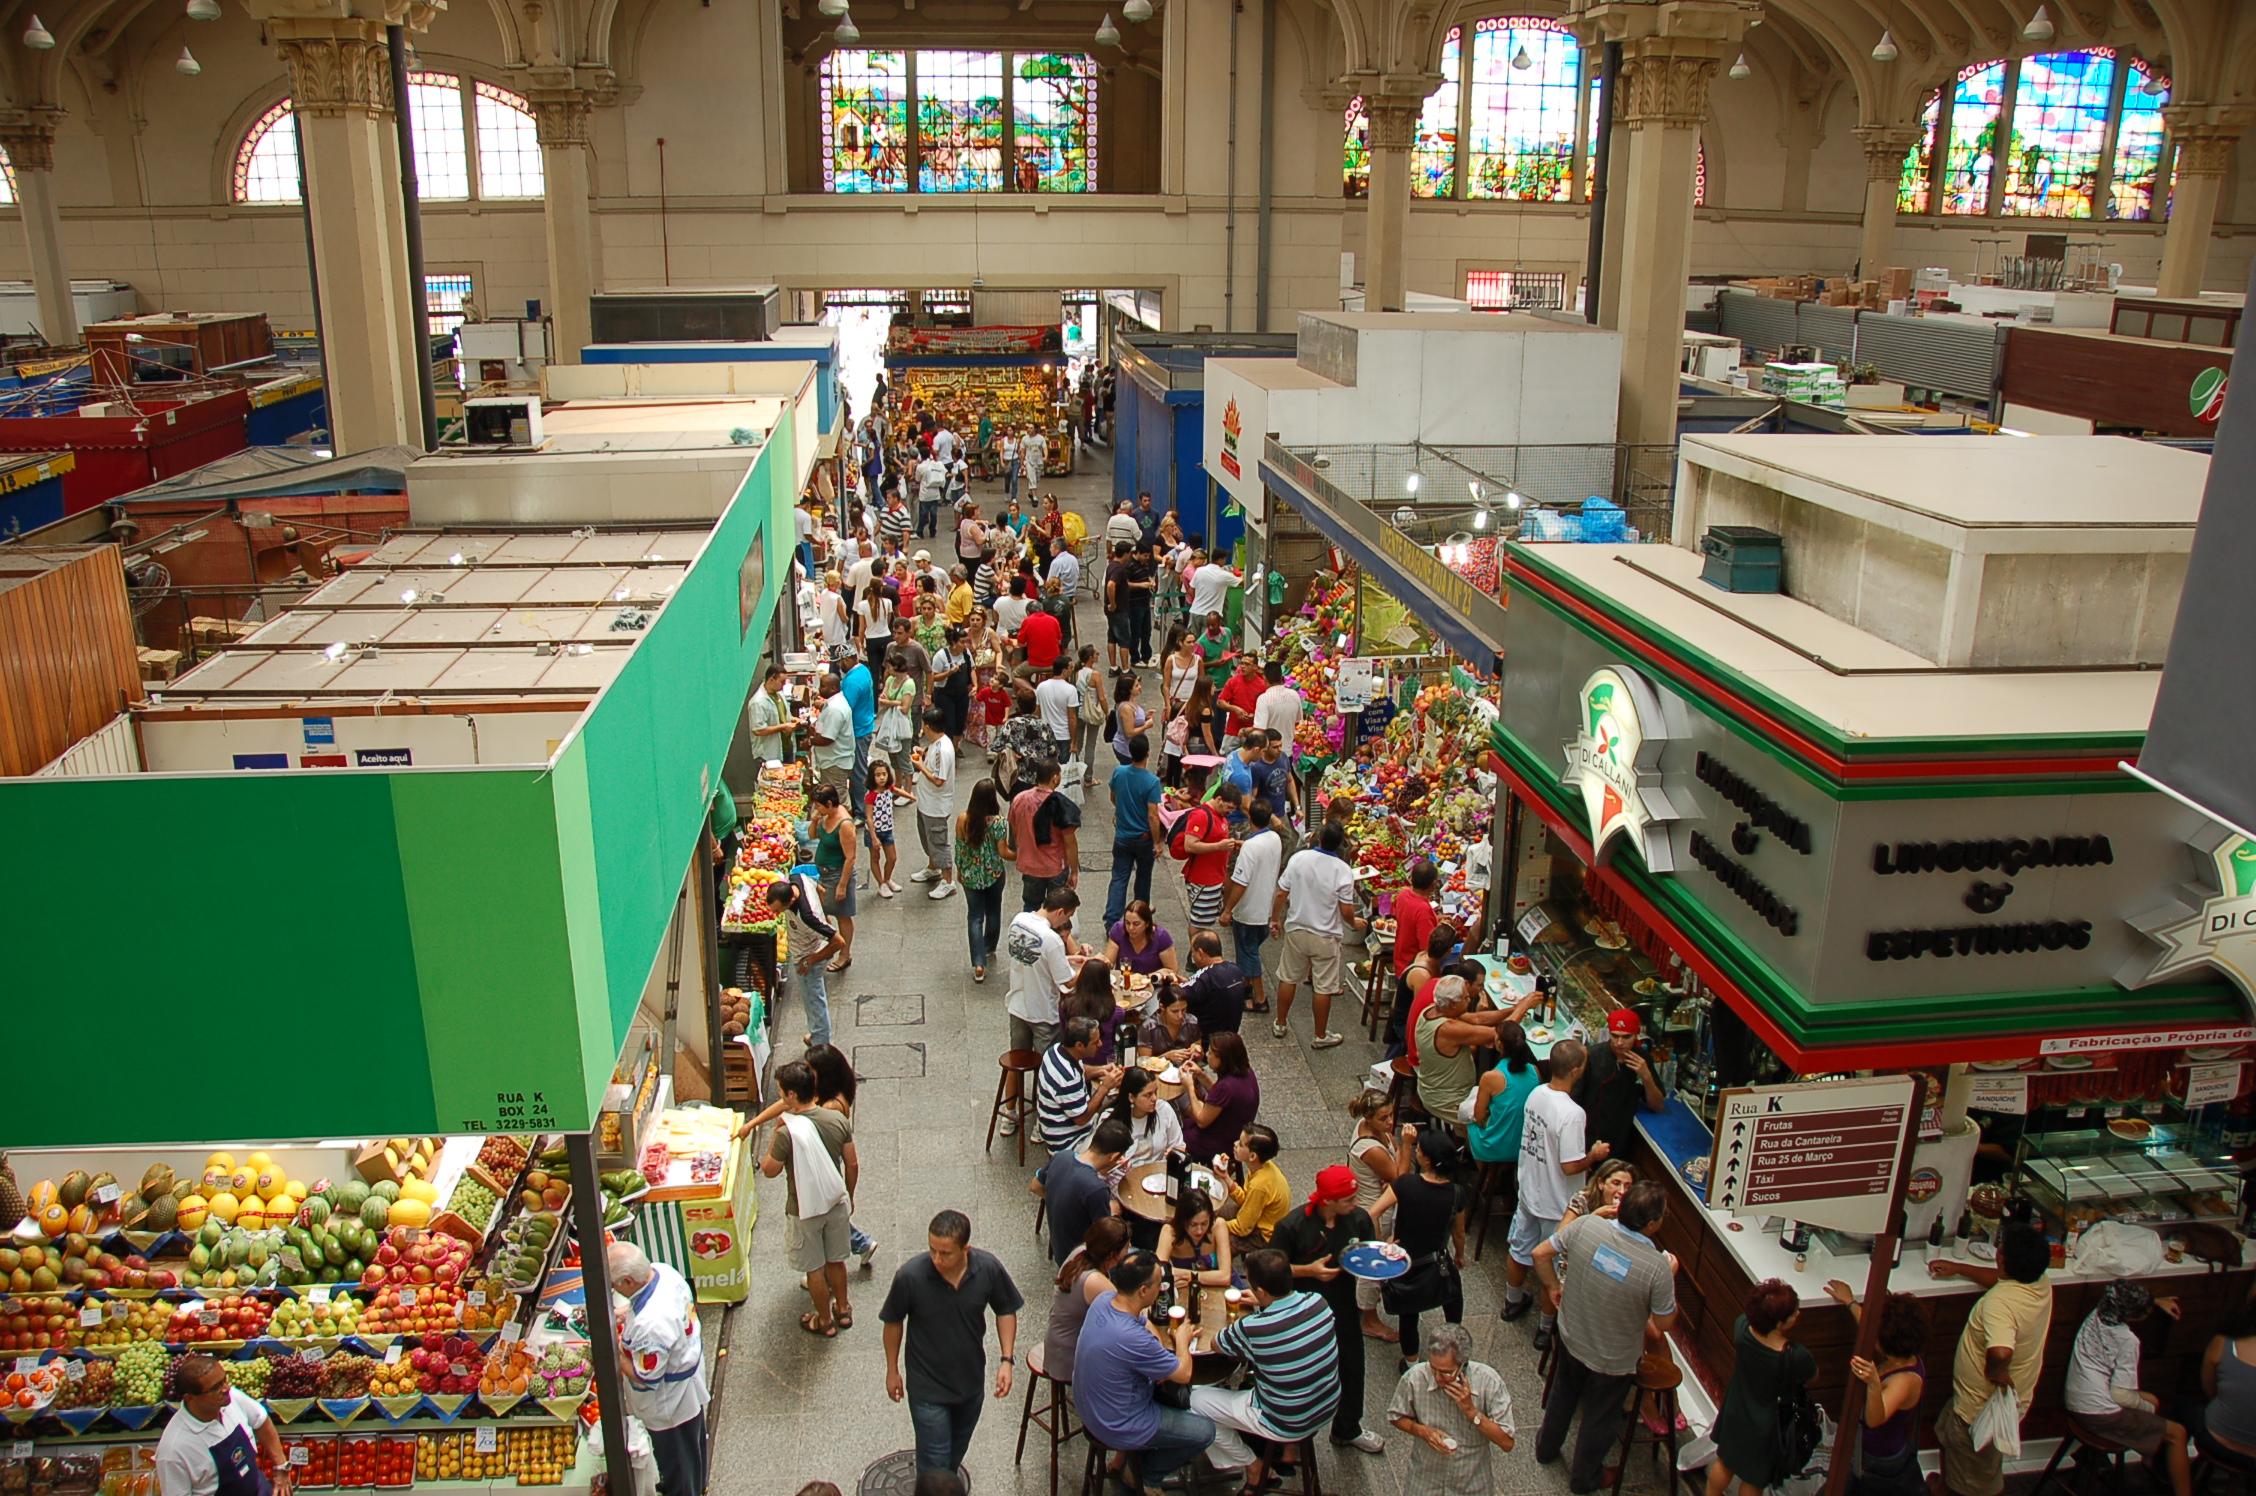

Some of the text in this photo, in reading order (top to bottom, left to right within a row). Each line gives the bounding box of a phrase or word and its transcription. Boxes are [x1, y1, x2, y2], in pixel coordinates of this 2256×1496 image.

[1462, 582, 1472, 616] 23
[1368, 708, 1383, 716] com
[1365, 717, 1380, 725] Visa
[361, 753, 408, 764] Aceito aqui
[1582, 748, 1632, 800] DI CALLANI
[1873, 834, 2114, 877] LINGUIÇARIA
[1962, 880, 2014, 914] &
[2211, 912, 2236, 932] DI
[1867, 920, 2093, 961] ESPETINHOS
[2069, 1029, 2253, 1048] Fabricação Própria de
[497, 1092, 544, 1103] RUA K
[499, 1105, 548, 1117] BOX 24
[1730, 1096, 1784, 1115] Rua K
[463, 1117, 556, 1131] TEL 3229-5831
[1763, 1121, 1793, 1131] Frutas
[1760, 1134, 1842, 1149] Rua da Cantareira
[1758, 1152, 1833, 1166] Rua 25 de Março
[1755, 1174, 1774, 1184] Táxi
[1751, 1192, 1780, 1202] Sucos
